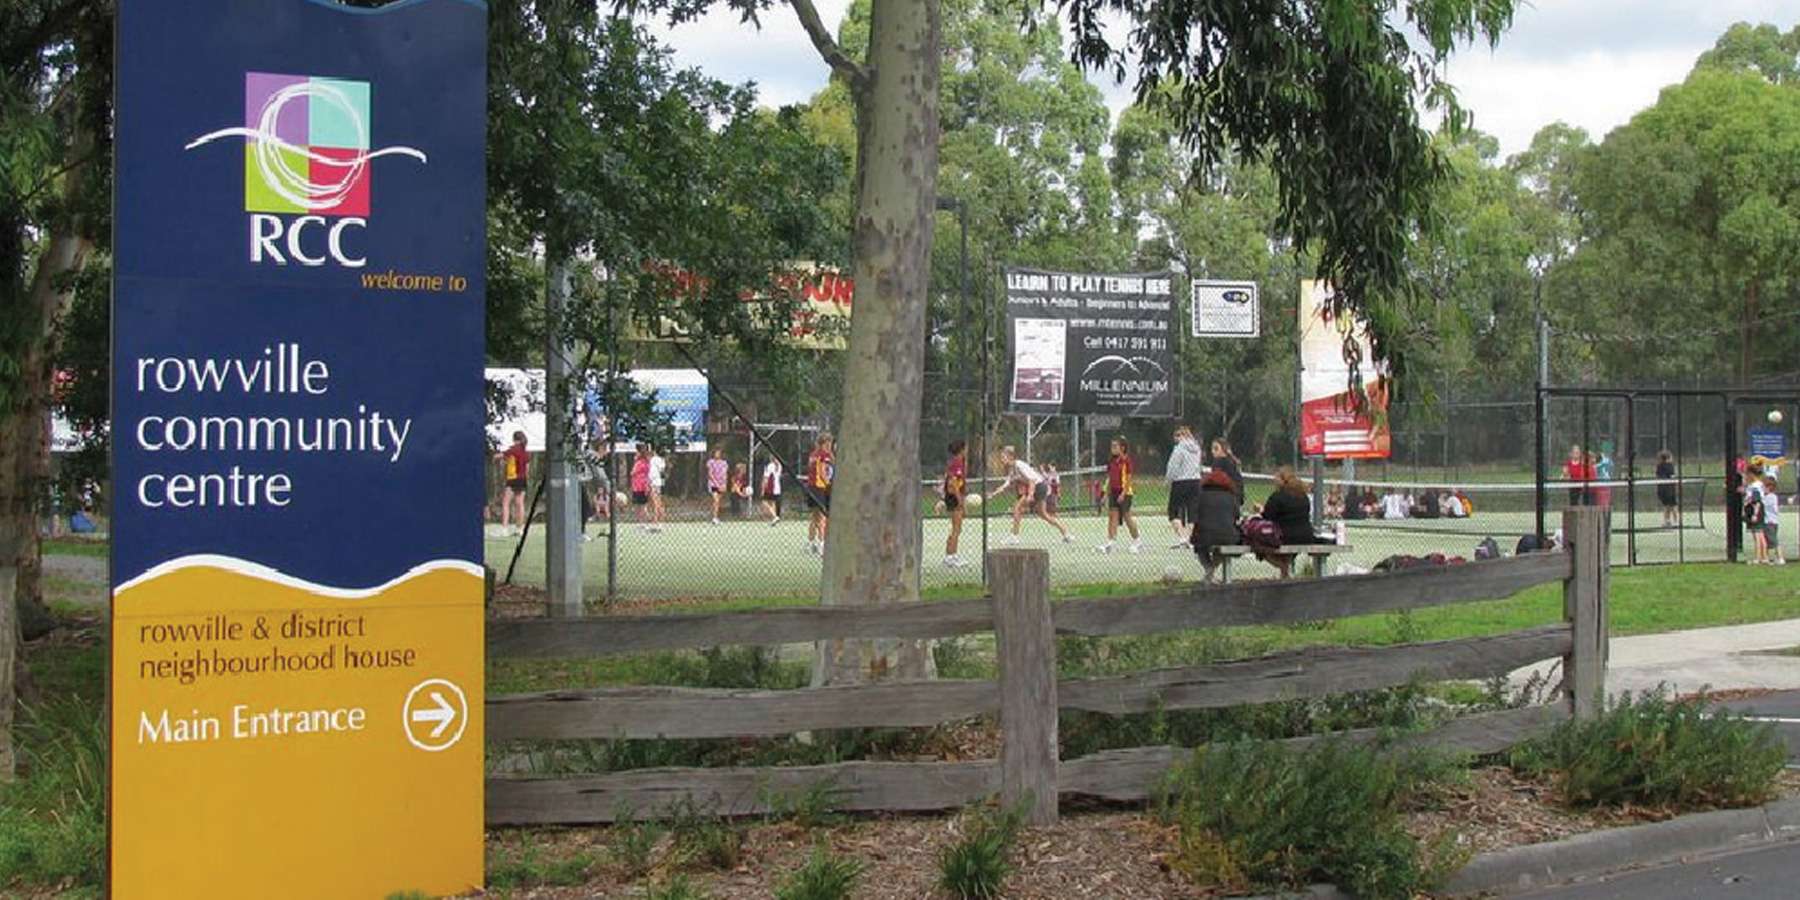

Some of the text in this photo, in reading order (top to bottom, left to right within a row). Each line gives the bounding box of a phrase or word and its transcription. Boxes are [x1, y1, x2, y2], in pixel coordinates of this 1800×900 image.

[249, 214, 368, 267] RCC
[361, 270, 467, 292] welcome to
[1007, 274, 1171, 295] LEARN TO PLAY TENNIS HERE
[1083, 336, 1103, 349] Call
[136, 342, 330, 395] rowville
[1080, 380, 1168, 393] MILLENNIUM
[136, 404, 412, 463] community
[137, 465, 292, 507] centre
[140, 612, 367, 643] rowville & district
[140, 644, 416, 685] neighbourhood house
[137, 704, 366, 744] Main Entrance
